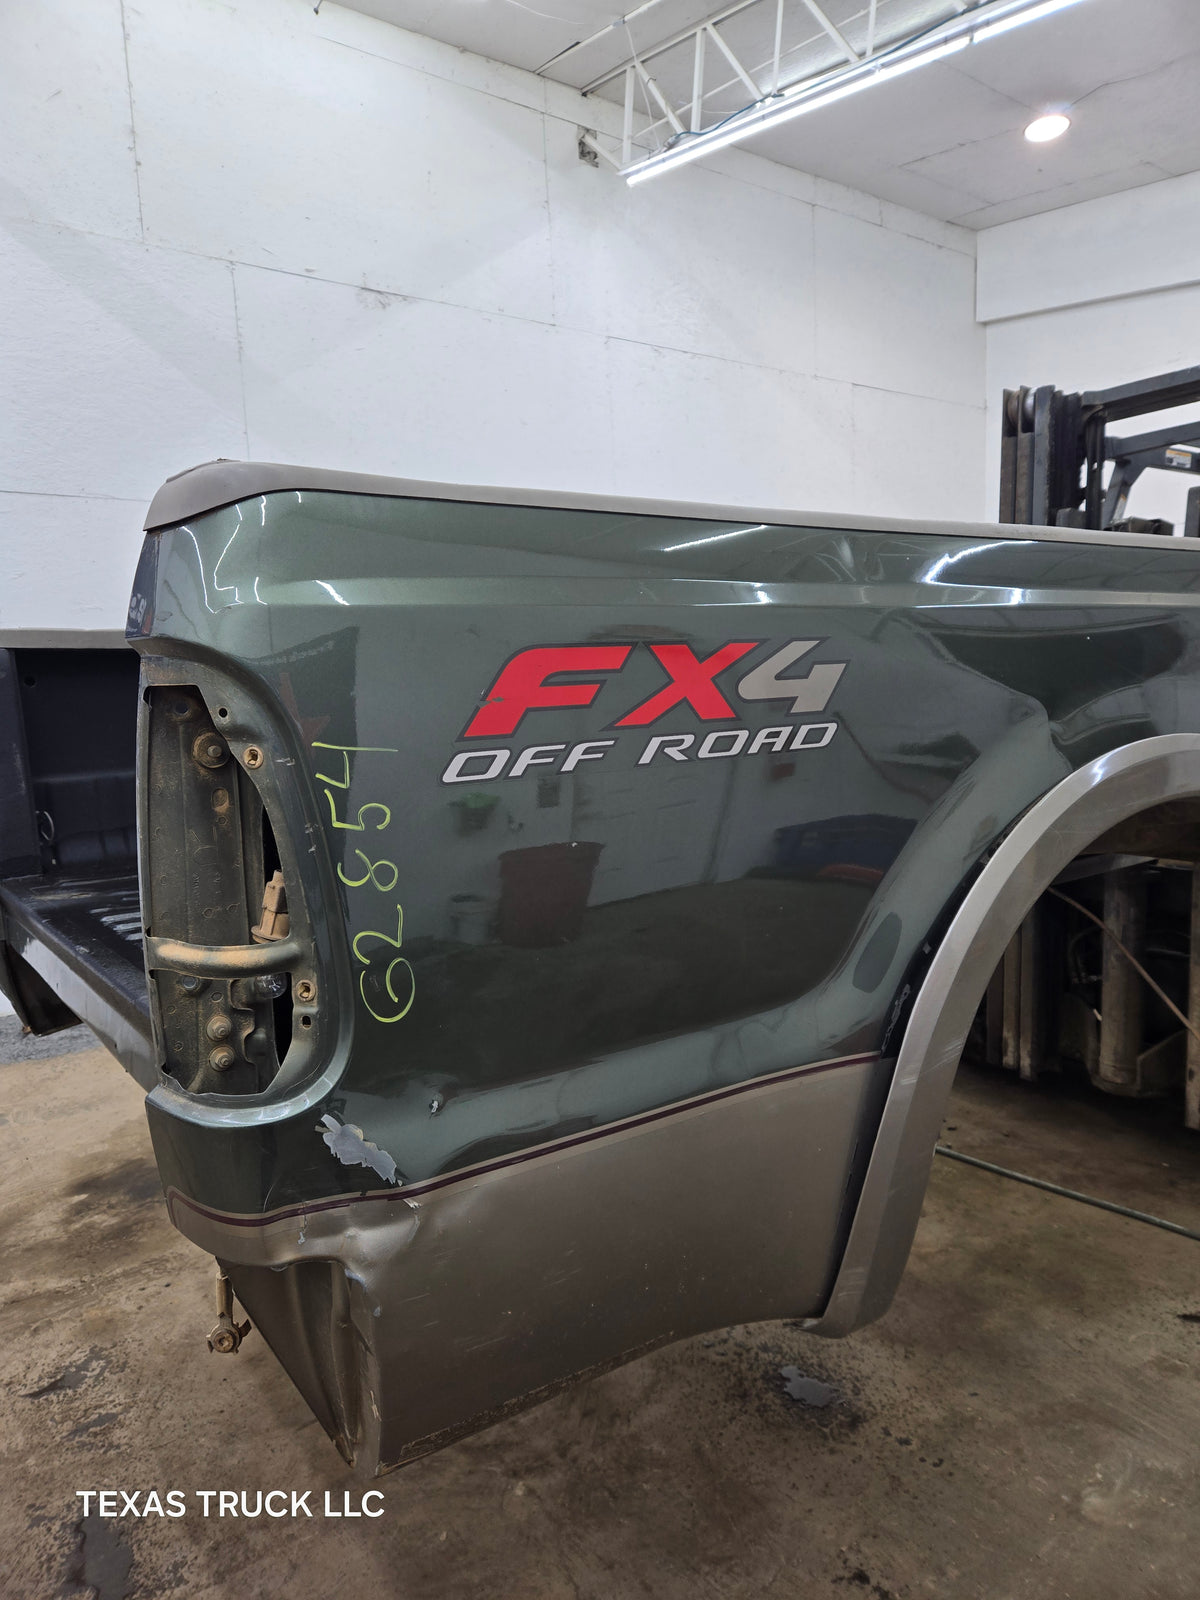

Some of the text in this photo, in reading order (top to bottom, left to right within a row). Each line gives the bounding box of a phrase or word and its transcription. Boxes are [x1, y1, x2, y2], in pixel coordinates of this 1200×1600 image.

[458, 638, 849, 740] FX4
[441, 722, 839, 784] OFF ROAD
[311, 741, 416, 1023] 62854
